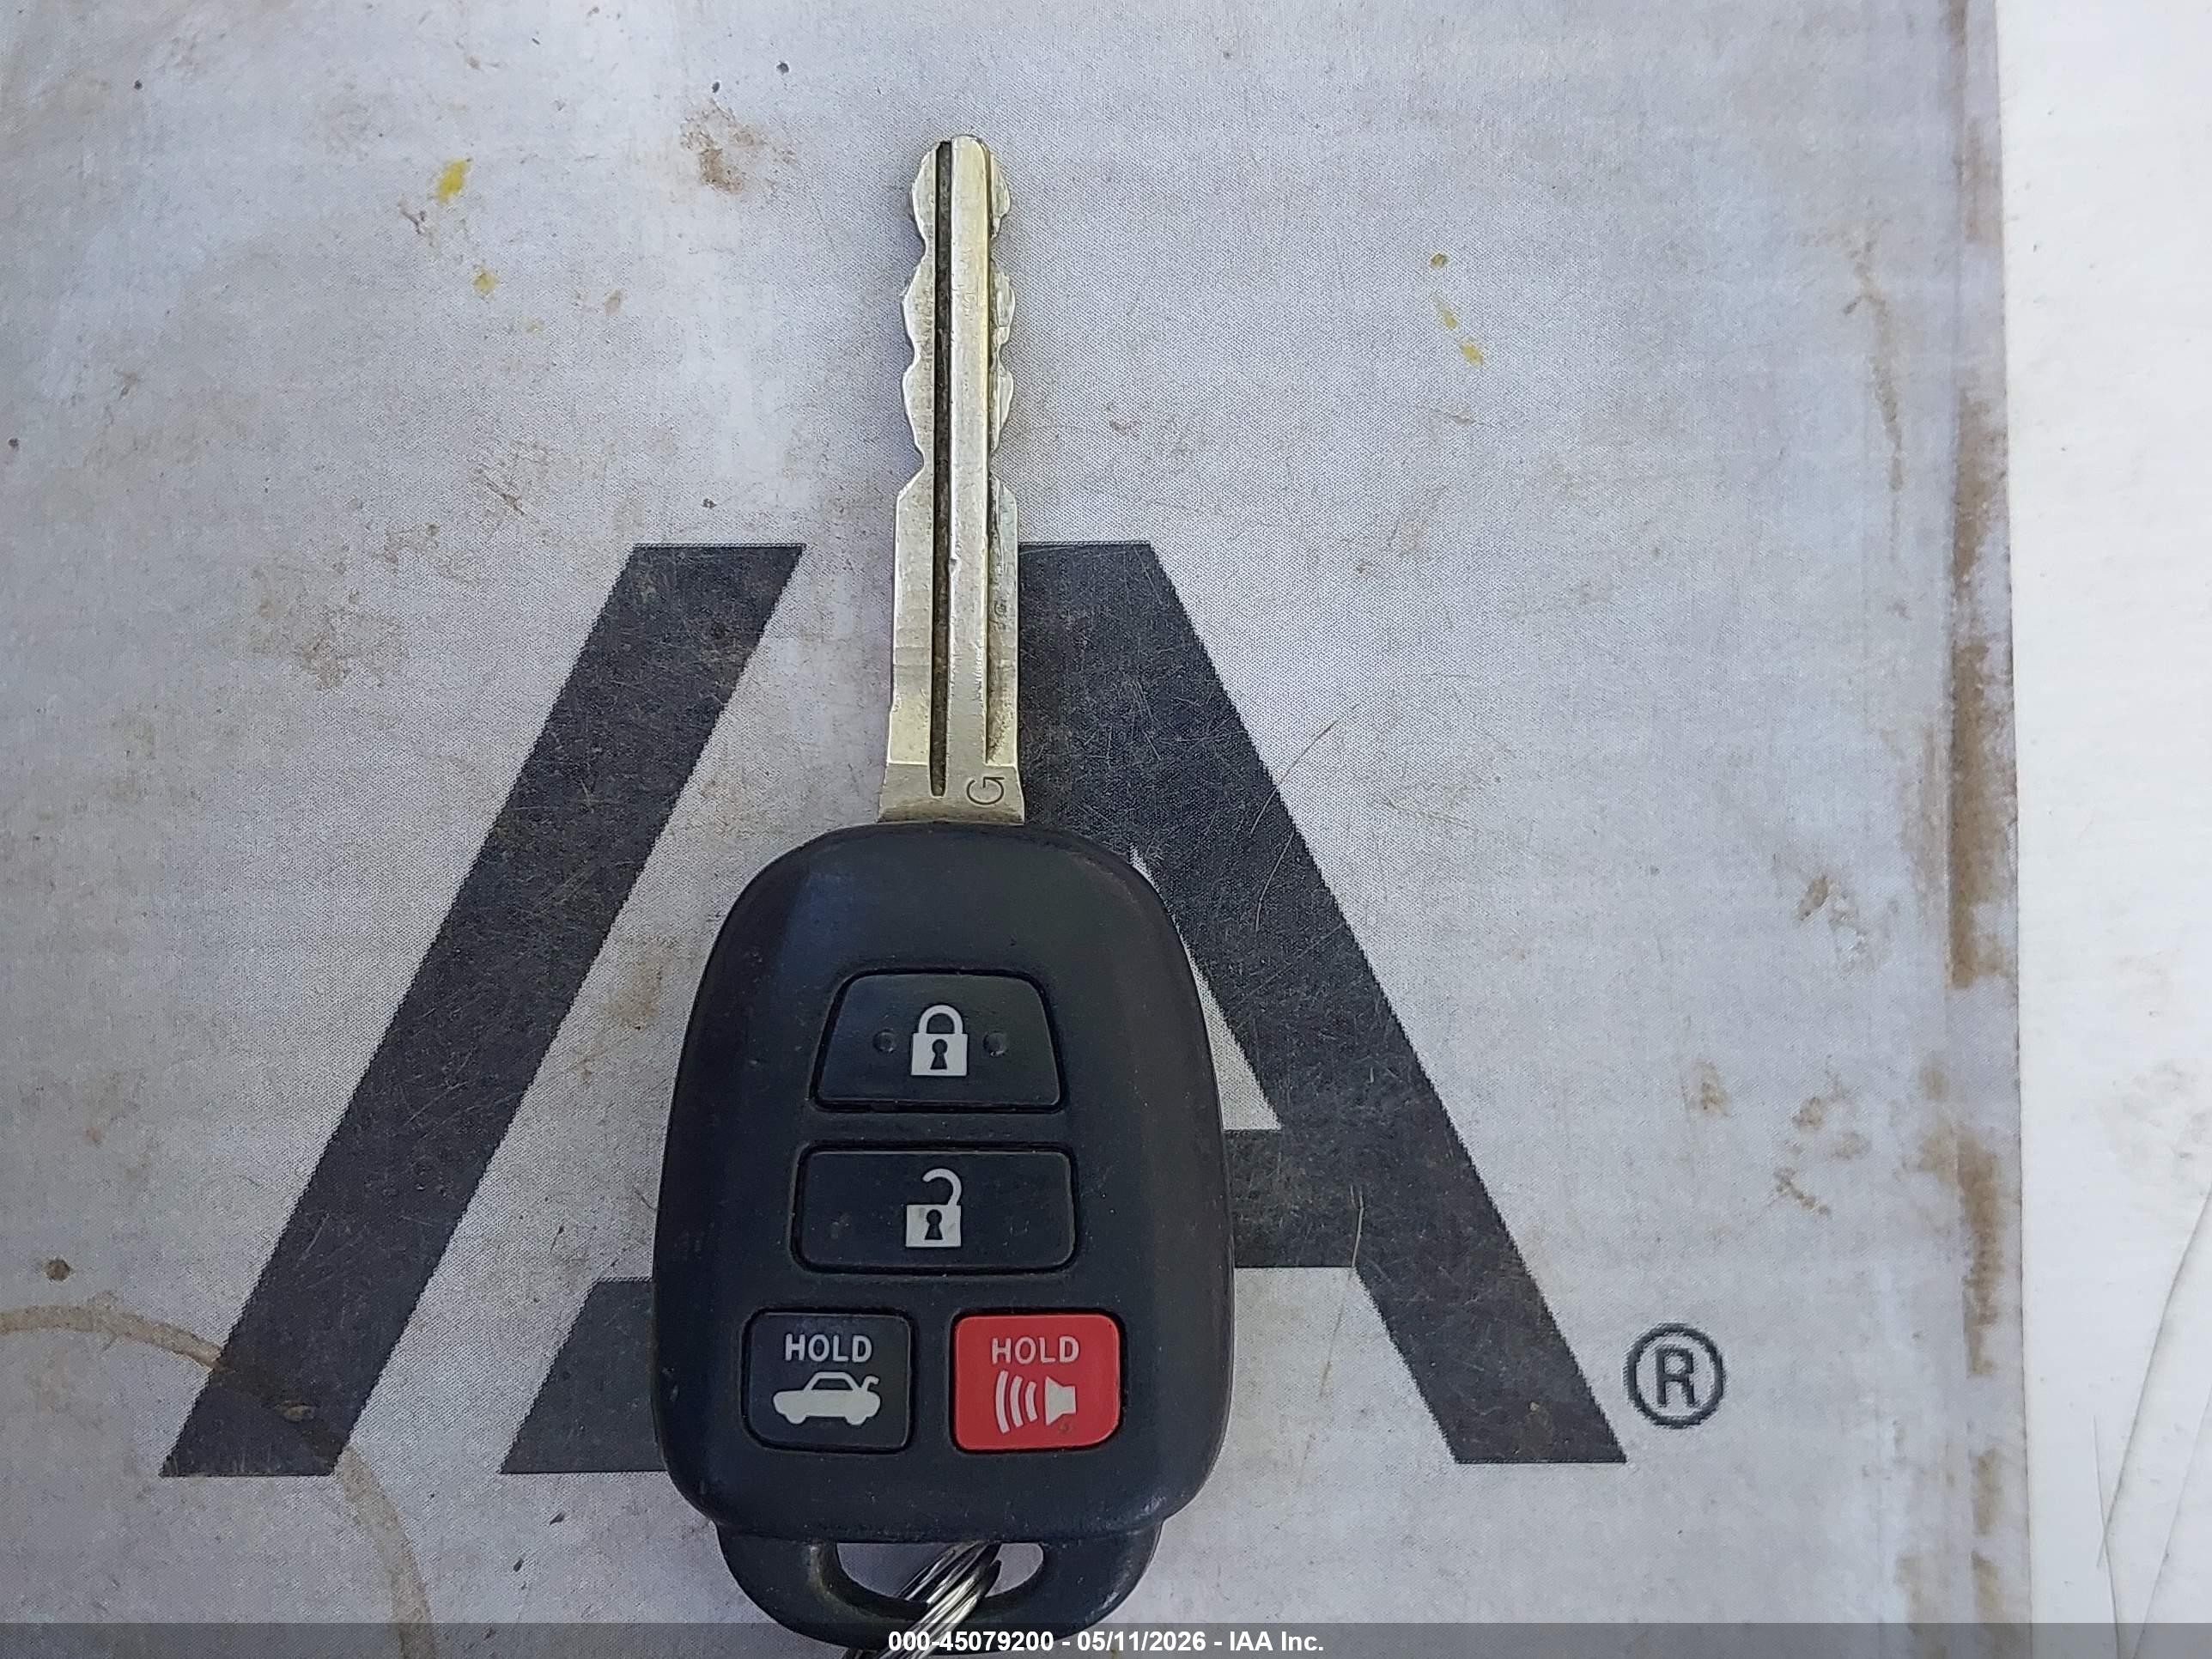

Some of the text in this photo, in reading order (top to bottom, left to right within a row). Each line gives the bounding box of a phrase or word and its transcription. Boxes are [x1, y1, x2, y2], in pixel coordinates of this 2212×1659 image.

[966, 775, 1006, 805] G
[784, 1334, 873, 1363] HOLD
[991, 1336, 1079, 1364] HOLD
